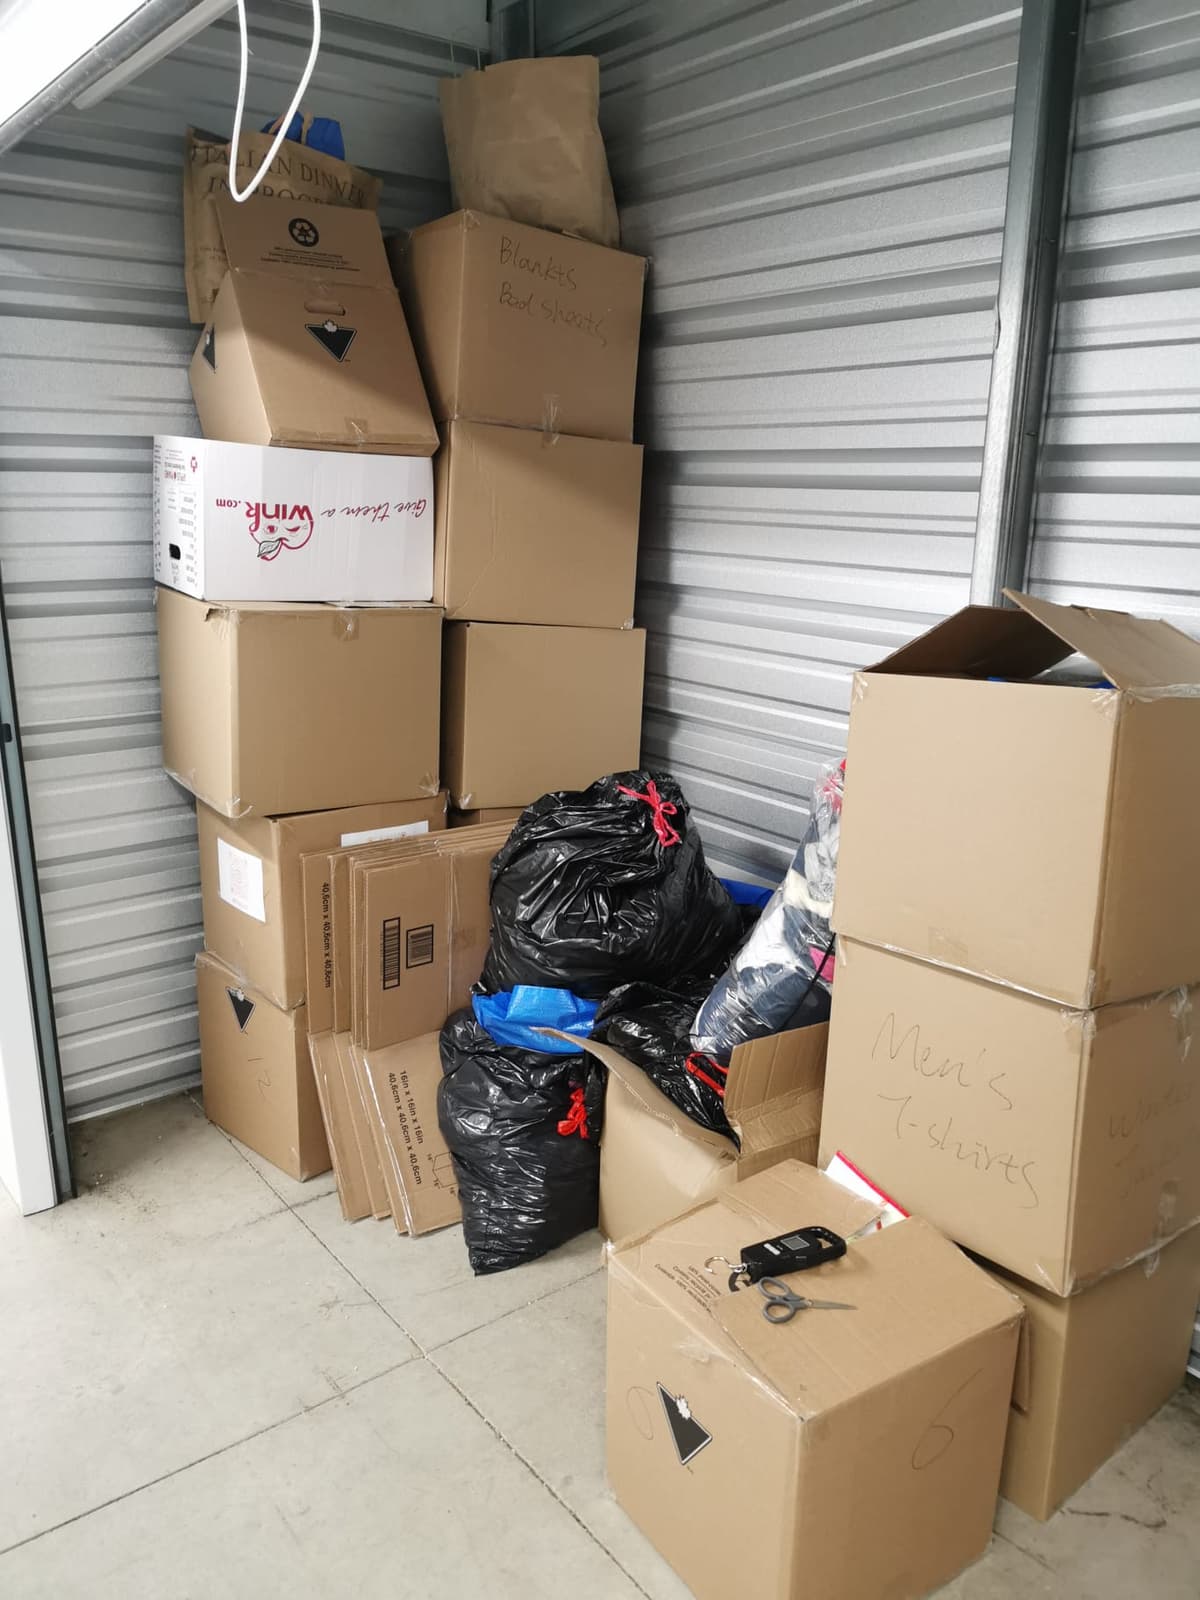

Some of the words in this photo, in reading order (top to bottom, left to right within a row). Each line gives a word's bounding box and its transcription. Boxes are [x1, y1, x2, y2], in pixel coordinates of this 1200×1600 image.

[320, 508, 336, 518] a
[343, 501, 389, 523] them
[394, 498, 428, 519] Give
[871, 1012, 1013, 1110] Men's
[388, 1072, 400, 1104] 40,6cm
[398, 1112, 411, 1144] 40,6cm
[409, 1152, 422, 1185] 40,6cm
[399, 1070, 409, 1089] 16in
[407, 1097, 416, 1116] 16in
[414, 1126, 424, 1145] 16in
